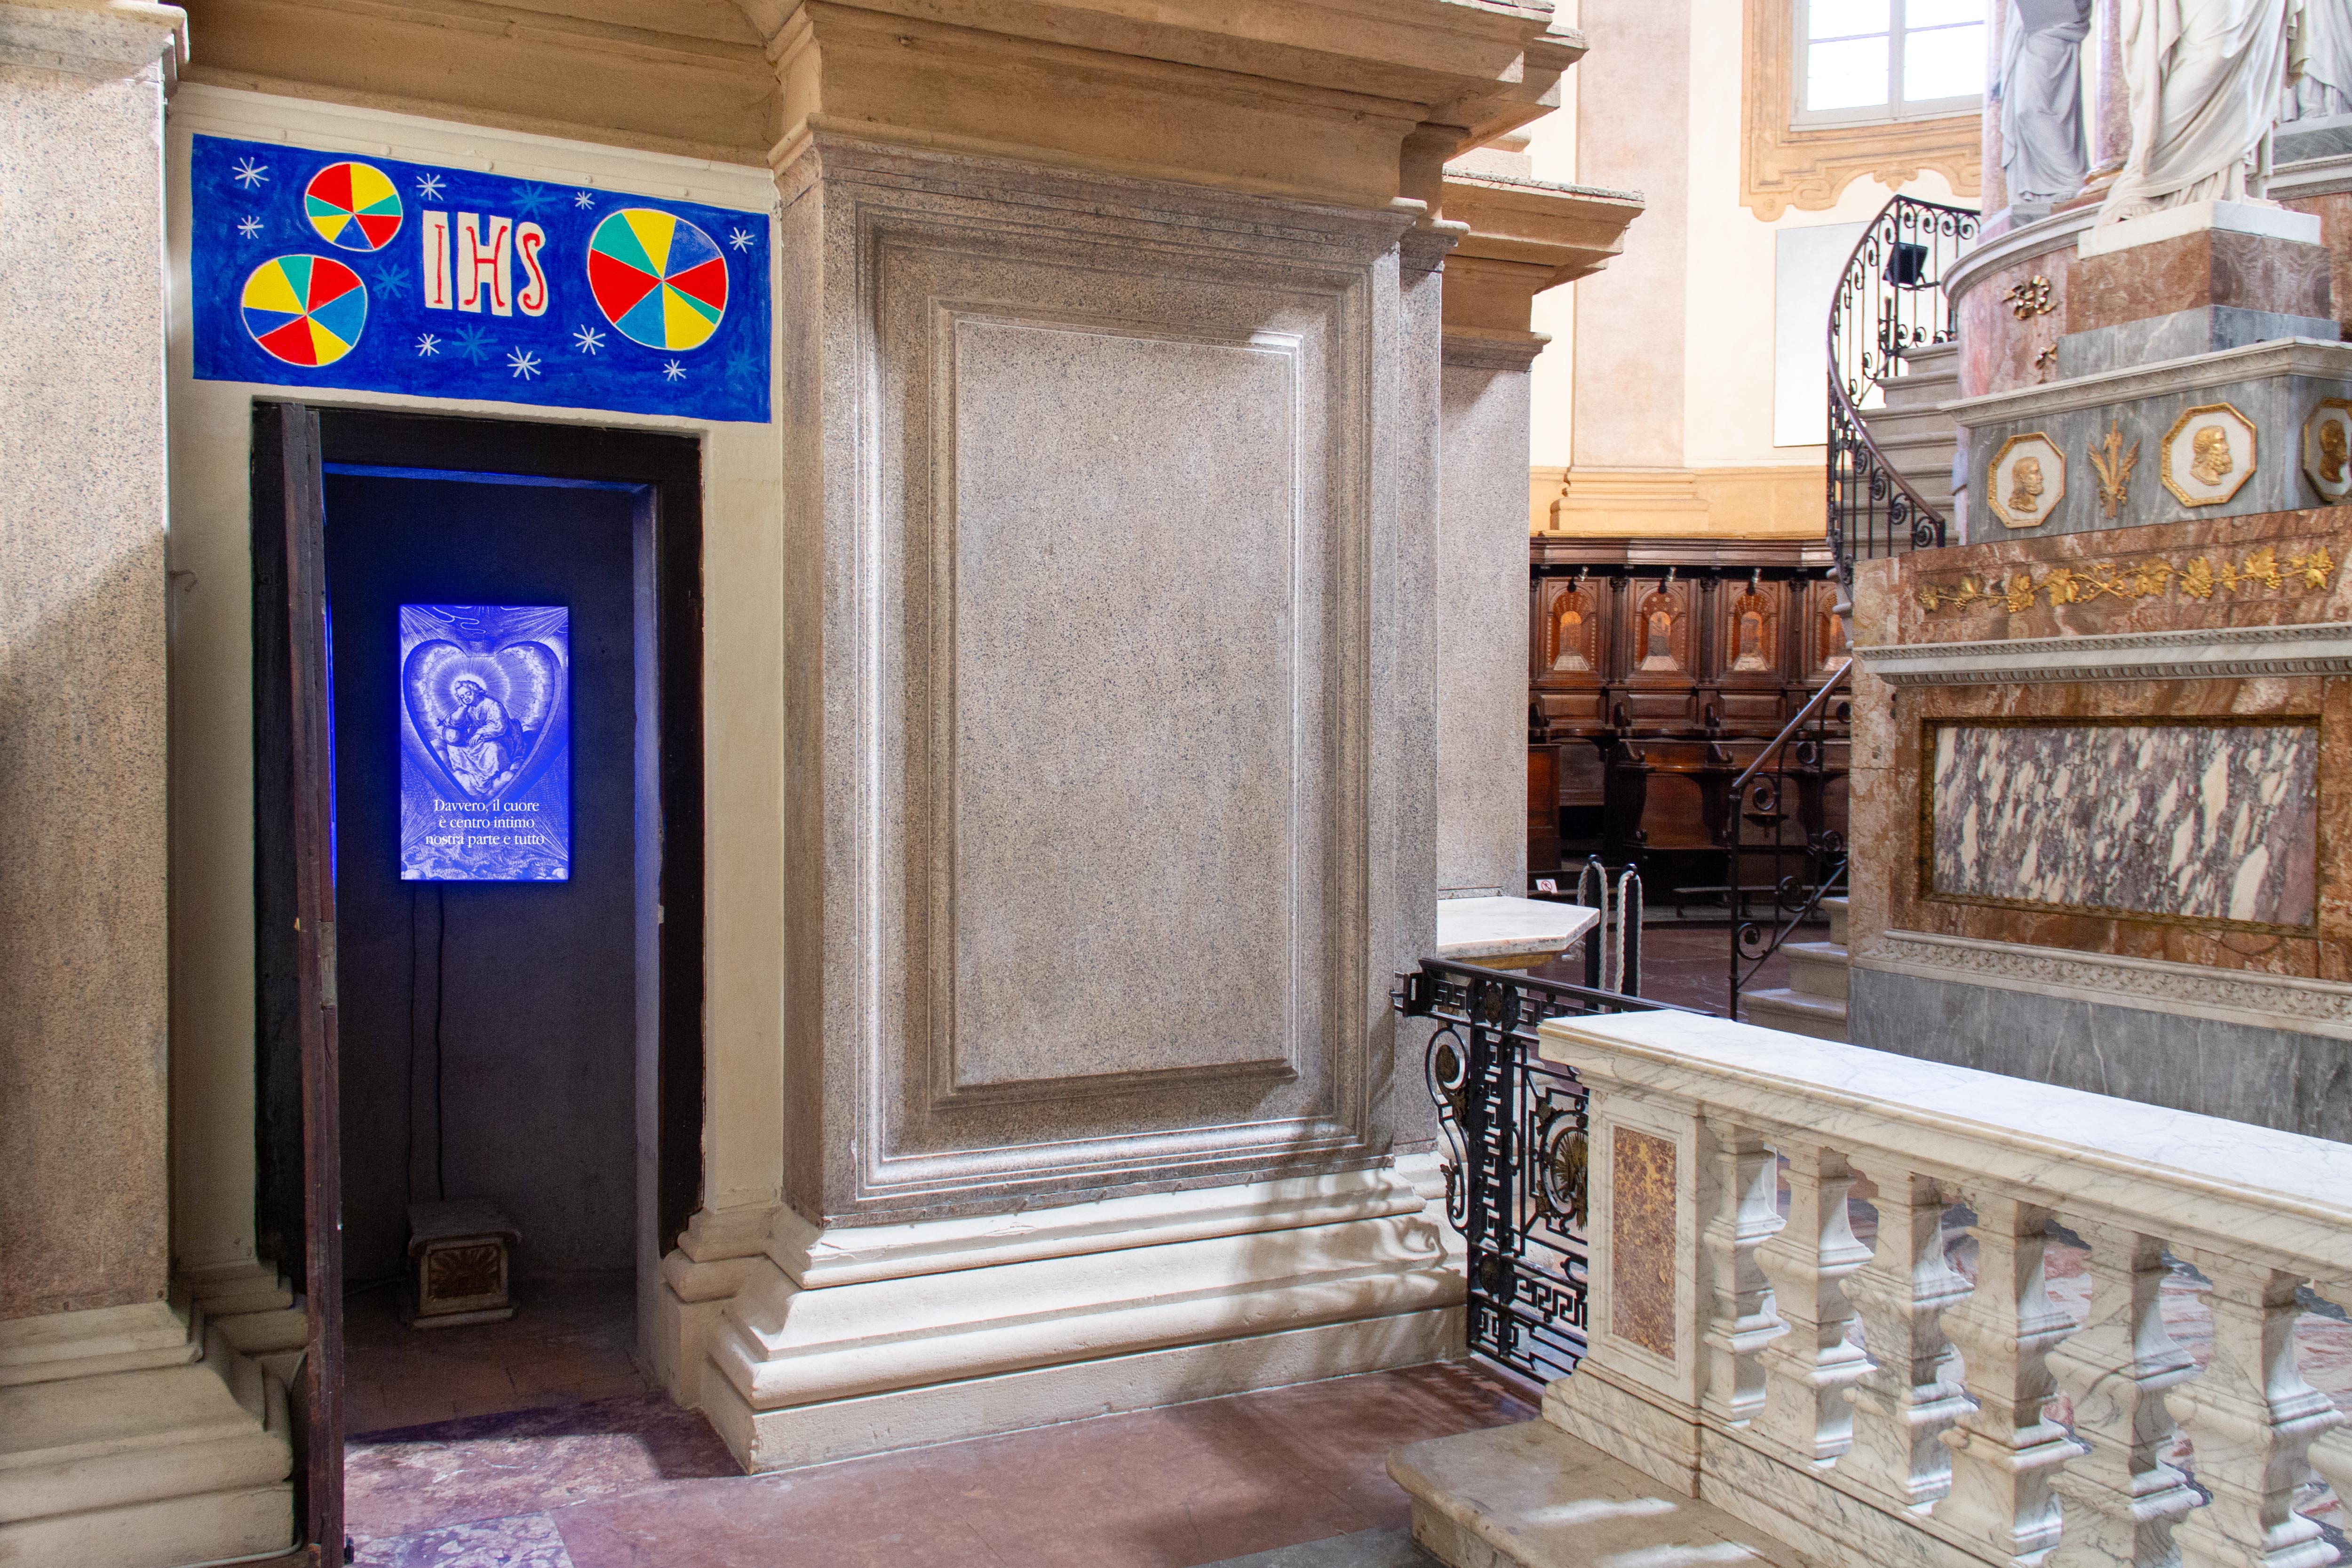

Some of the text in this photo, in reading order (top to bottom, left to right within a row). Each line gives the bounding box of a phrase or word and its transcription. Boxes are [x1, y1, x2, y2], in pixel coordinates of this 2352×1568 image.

[422, 210, 548, 317] IHS
[434, 799, 540, 813] Davvero, il cuore
[439, 815, 535, 828] è centro intimo
[425, 835, 545, 848] nostra parte e tutto
